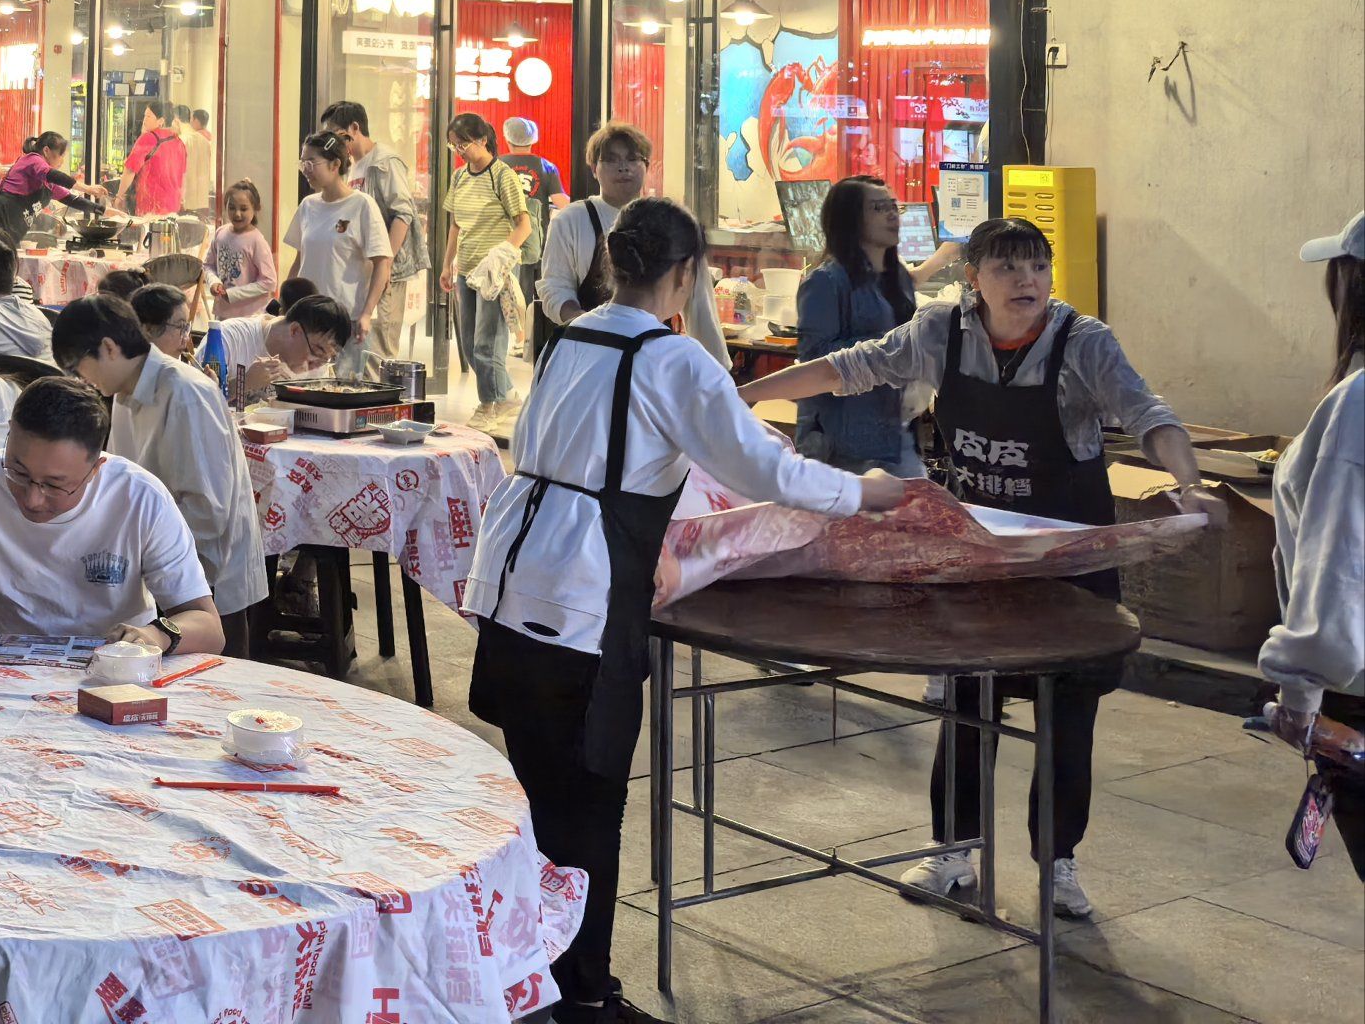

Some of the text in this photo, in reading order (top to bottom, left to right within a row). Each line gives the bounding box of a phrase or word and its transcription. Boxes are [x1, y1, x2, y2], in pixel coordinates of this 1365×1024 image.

[954, 428, 1029, 468] 皮皮
[955, 466, 1032, 496] 大排档
